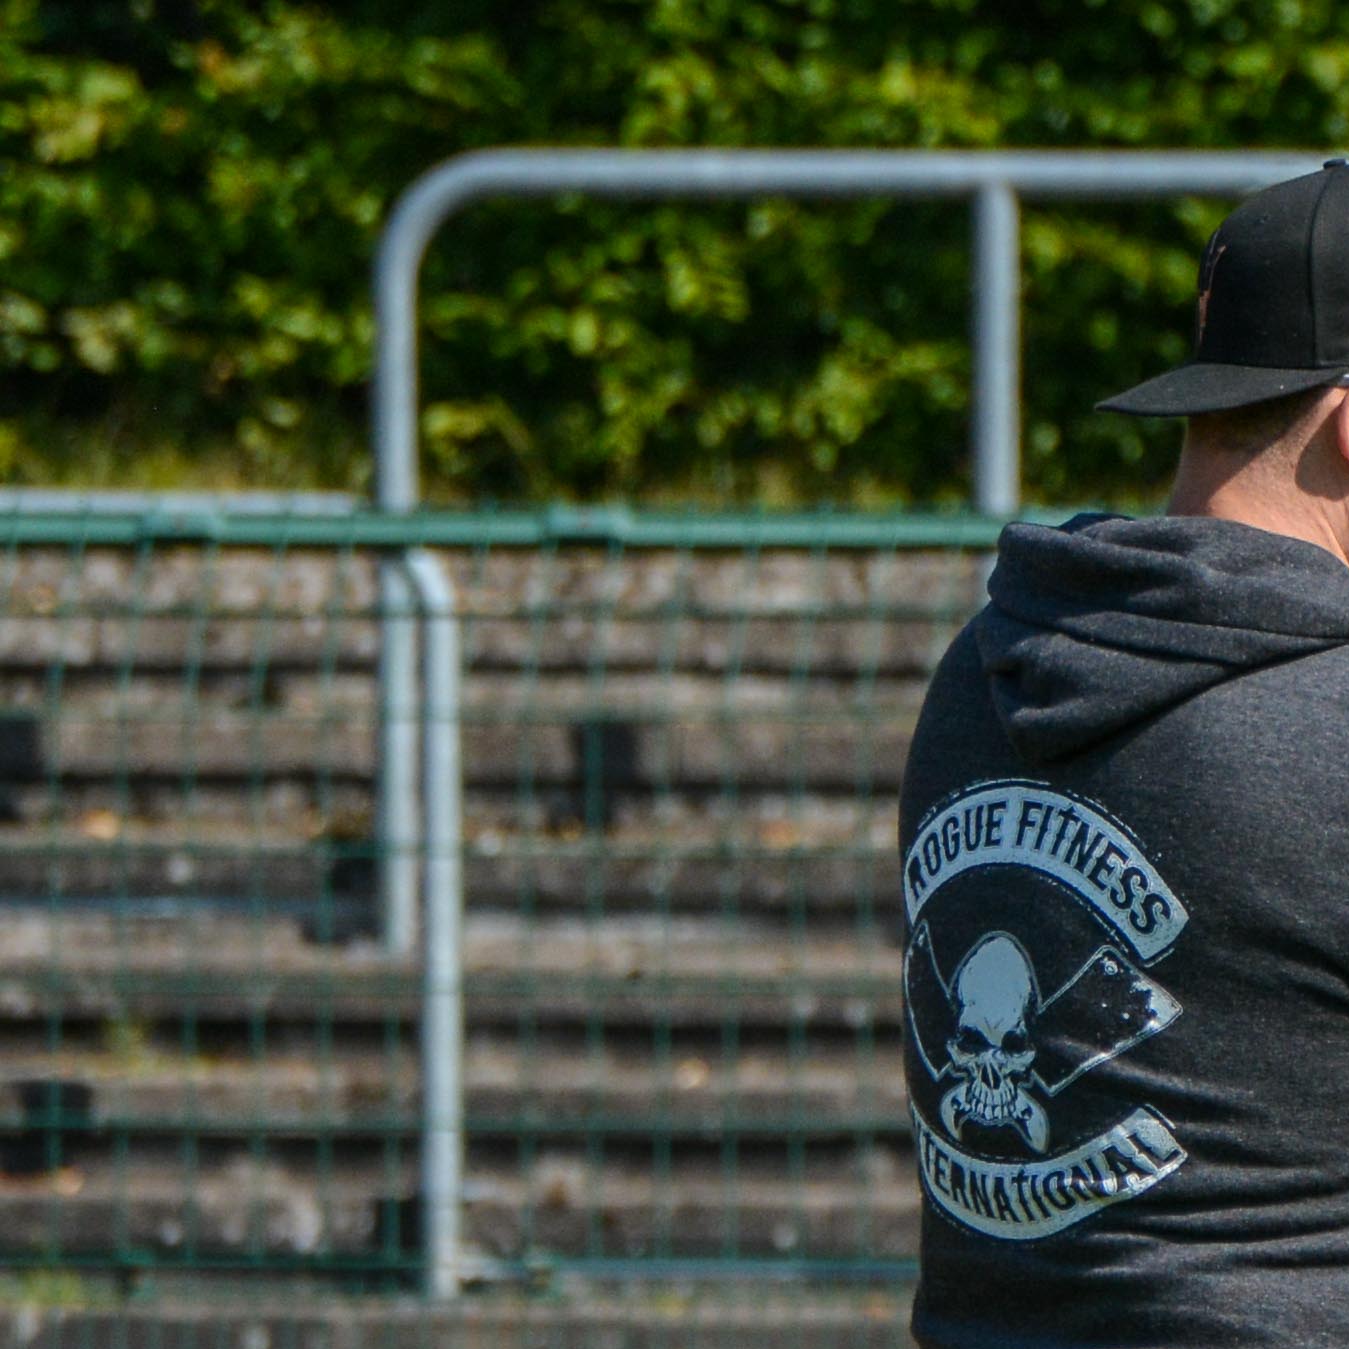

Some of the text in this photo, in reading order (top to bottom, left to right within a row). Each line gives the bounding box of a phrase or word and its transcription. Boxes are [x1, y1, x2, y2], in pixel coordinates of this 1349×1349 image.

[906, 799, 1172, 935] ROGUE FITNESS
[918, 1126, 1186, 1223] TERNATIONAL
